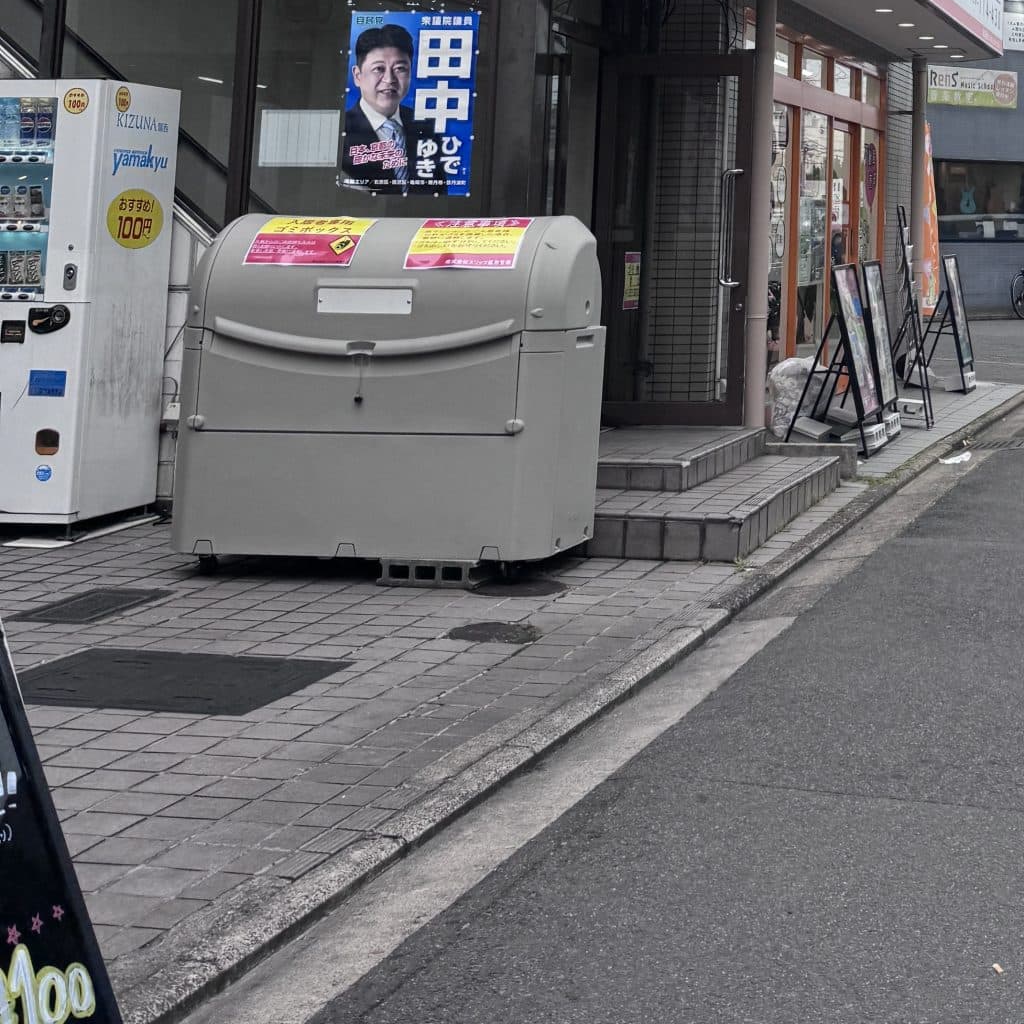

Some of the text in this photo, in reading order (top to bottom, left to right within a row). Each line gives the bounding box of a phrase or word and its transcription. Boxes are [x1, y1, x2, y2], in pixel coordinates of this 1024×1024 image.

[356, 16, 384, 25] 自民党
[421, 16, 472, 26] 衆議院議員
[414, 29, 473, 133] 田中
[112, 144, 168, 176] yamakyu
[416, 139, 438, 178] ゆき
[440, 136, 462, 175] ひで
[274, 225, 352, 234] ゴミボックス
